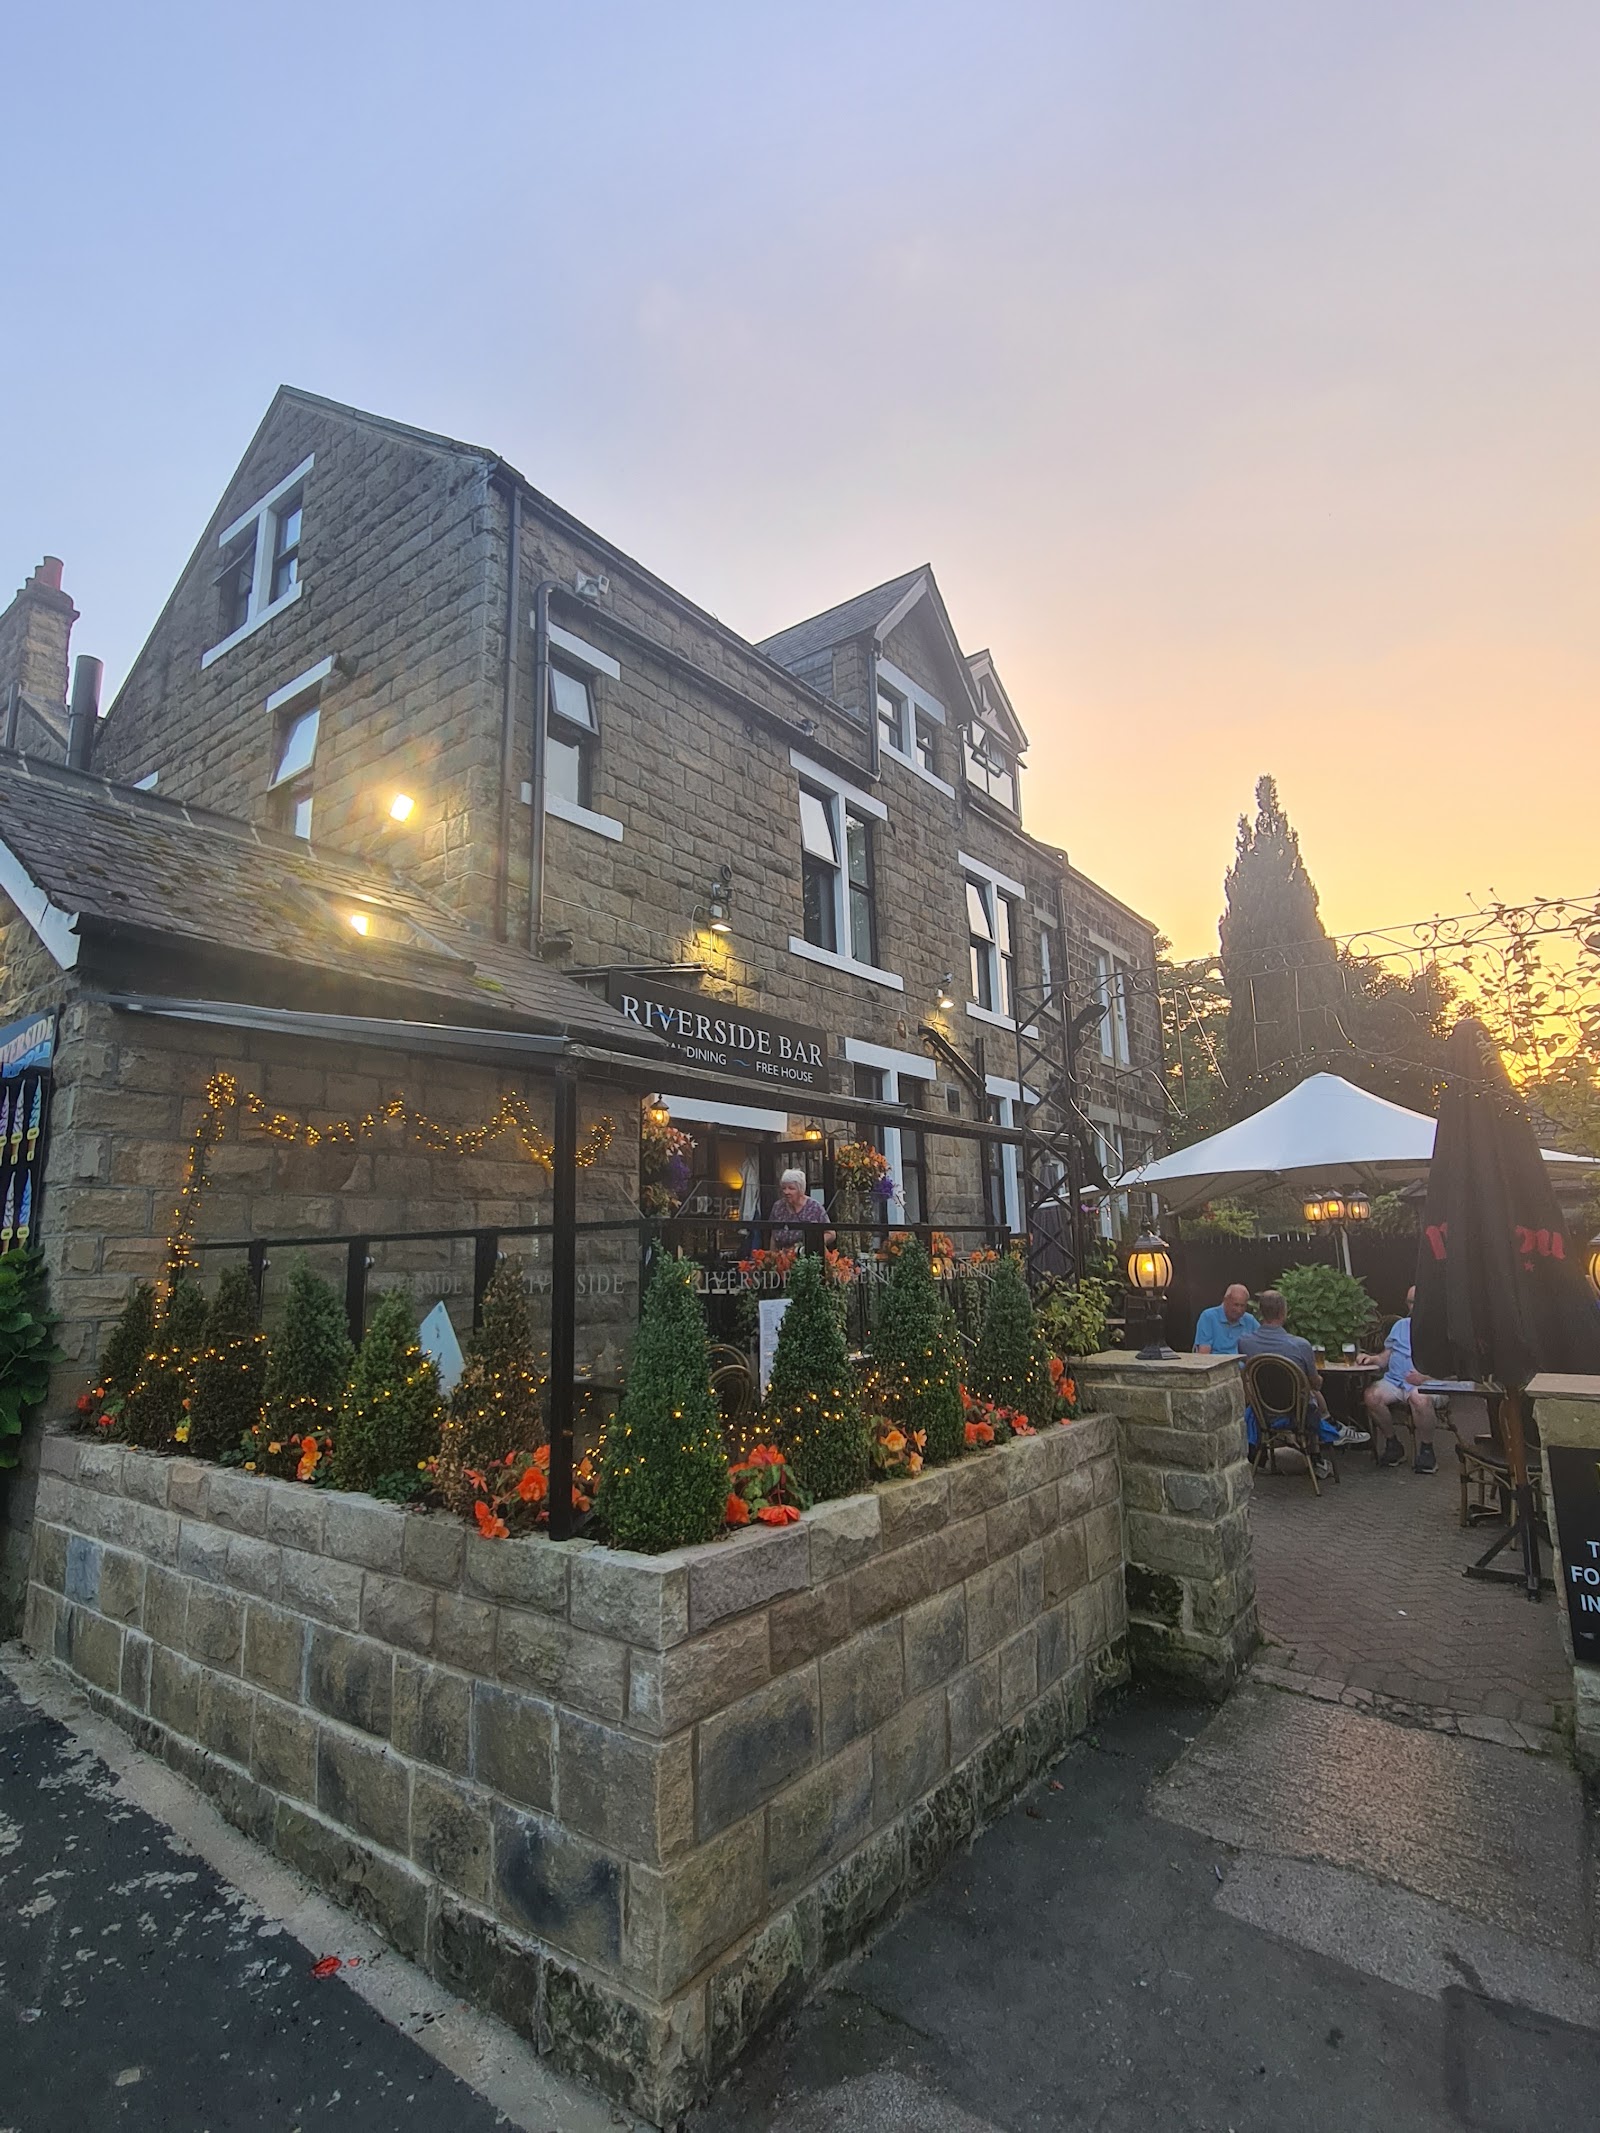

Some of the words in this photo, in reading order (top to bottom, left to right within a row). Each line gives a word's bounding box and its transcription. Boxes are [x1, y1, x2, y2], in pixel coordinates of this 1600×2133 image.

[621, 994, 772, 1055] RIVERSIDE
[778, 1035, 824, 1067] BAR
[686, 1046, 727, 1065] DINING
[756, 1061, 779, 1077] FREE
[781, 1066, 813, 1083] HOUSE
[1571, 1566, 1600, 1585] FO
